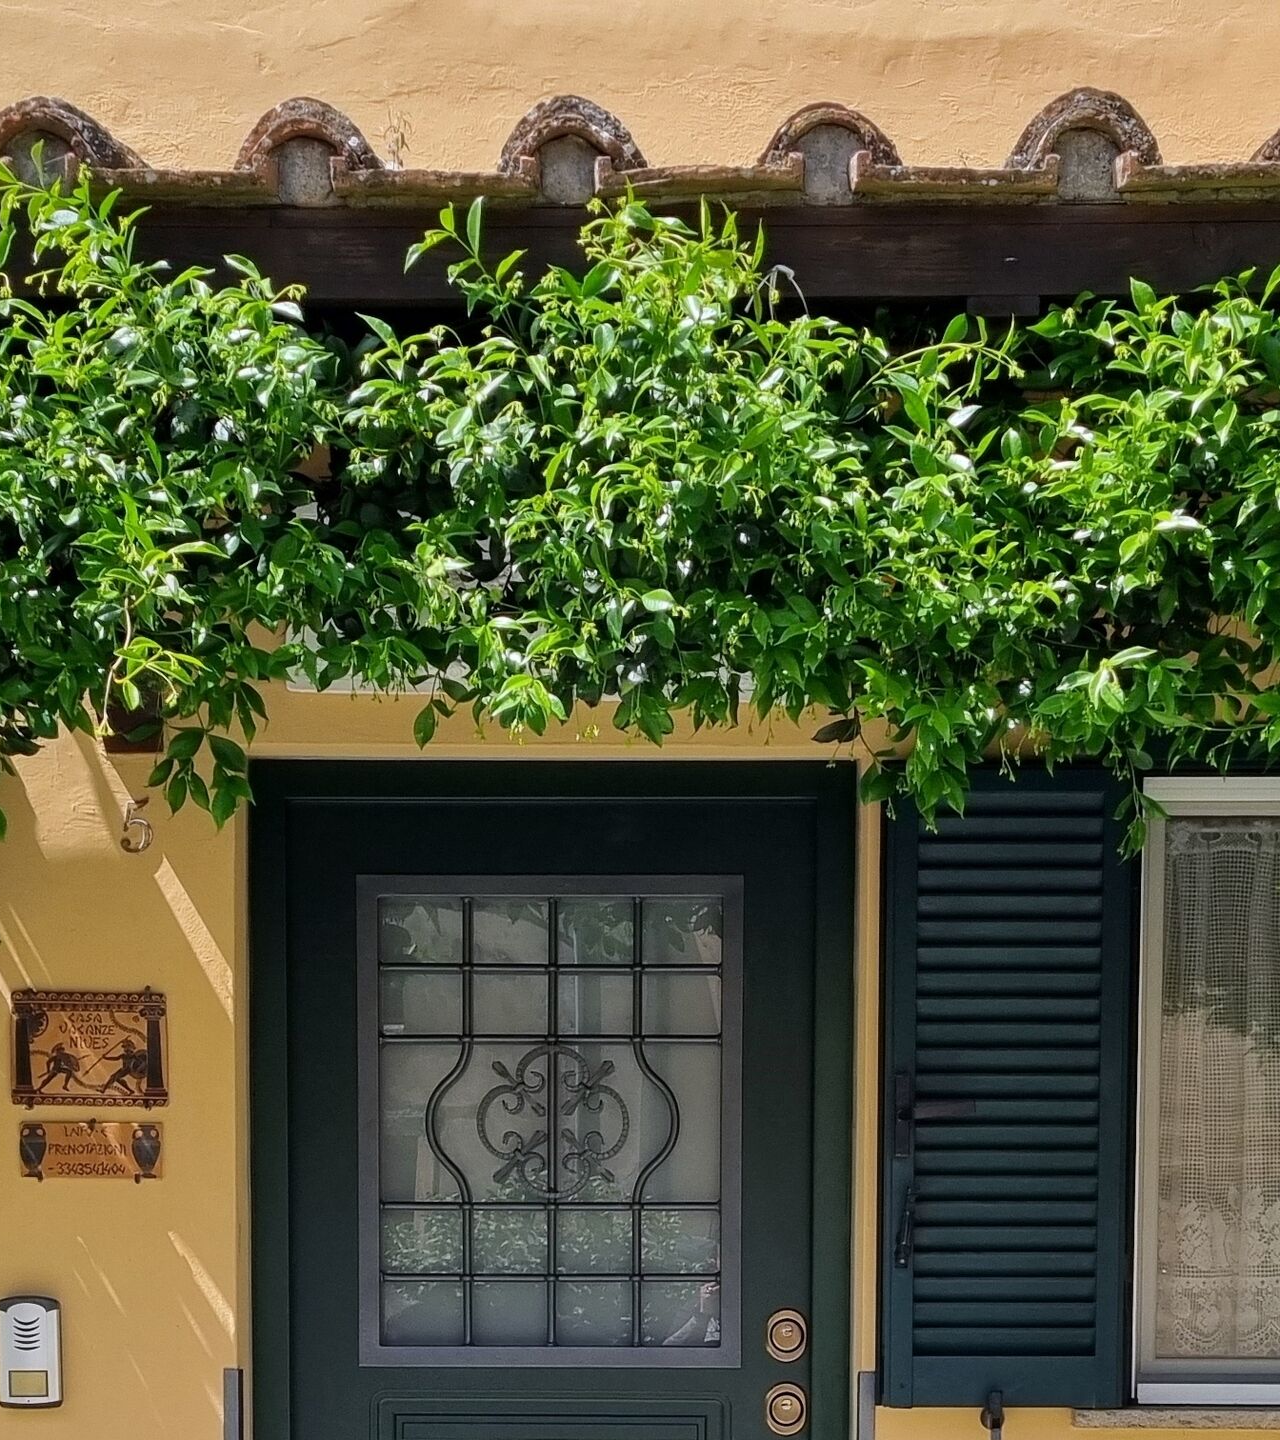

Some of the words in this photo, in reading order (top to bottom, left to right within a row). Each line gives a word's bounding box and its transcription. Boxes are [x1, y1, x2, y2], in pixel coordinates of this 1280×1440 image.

[68, 1012, 103, 1024] CASA
[58, 1021, 116, 1036] VACANZE
[69, 1036, 109, 1050] NIVES
[47, 1143, 127, 1157] PRENOTAZIONI
